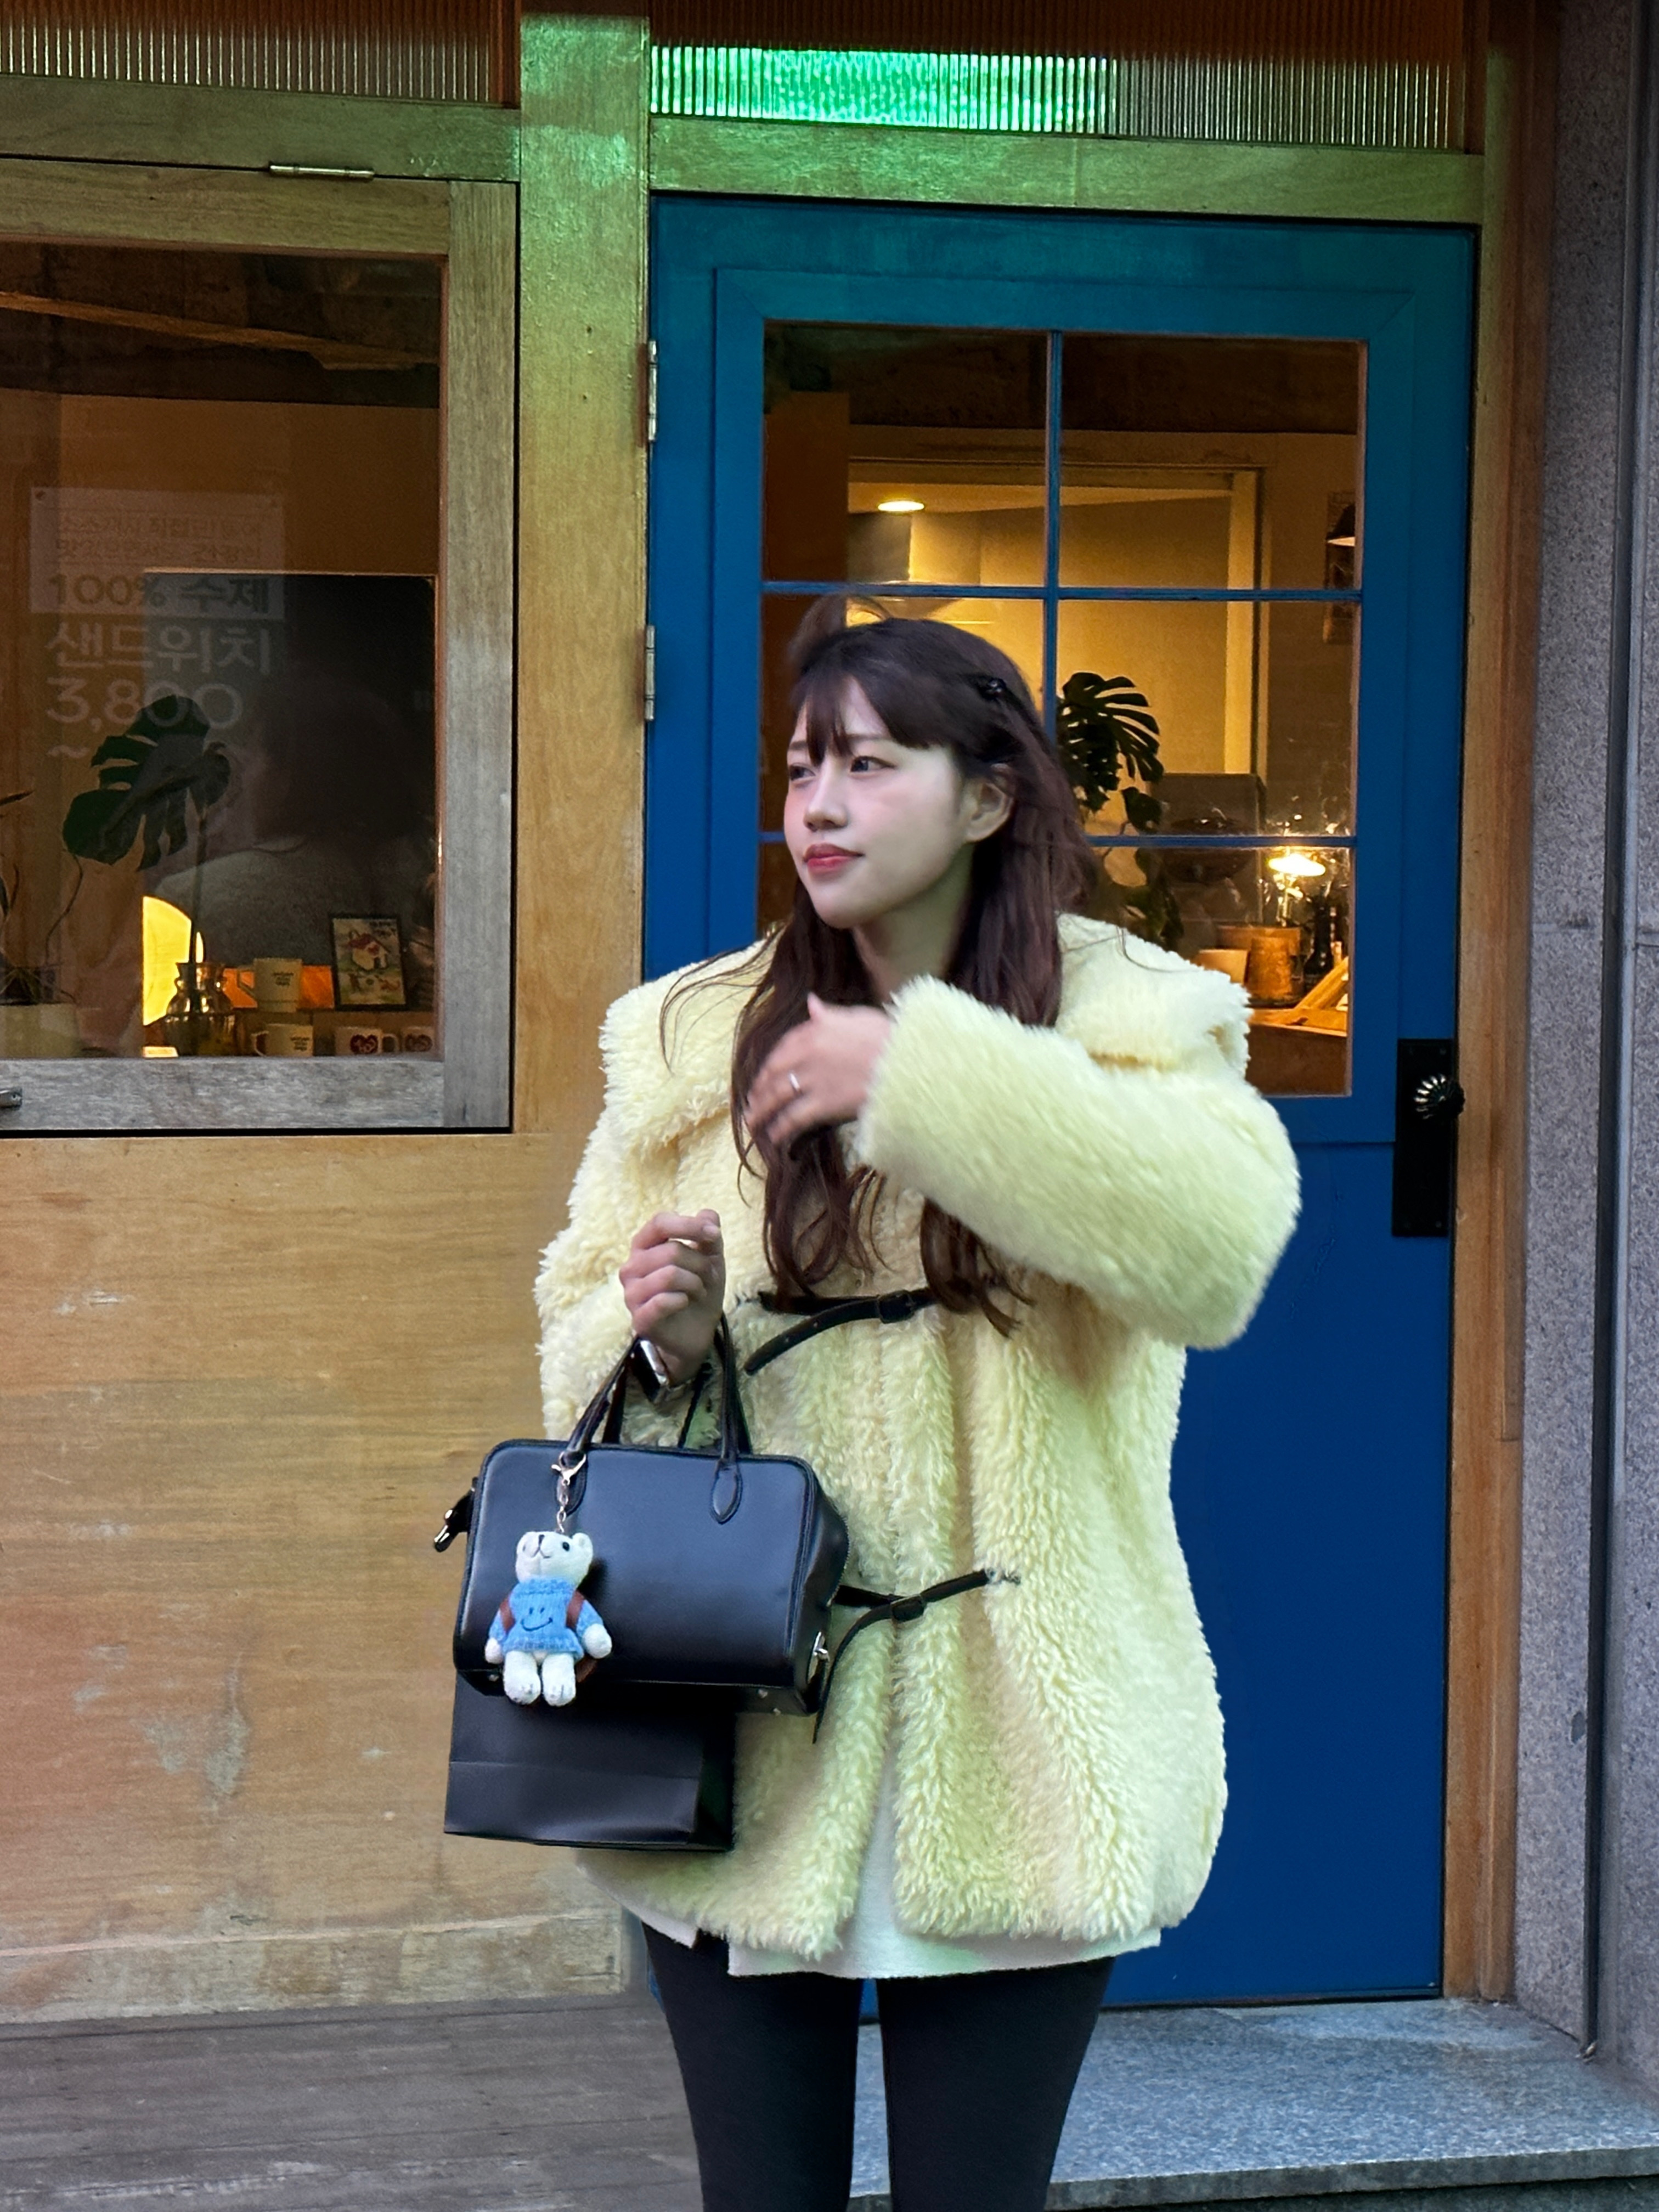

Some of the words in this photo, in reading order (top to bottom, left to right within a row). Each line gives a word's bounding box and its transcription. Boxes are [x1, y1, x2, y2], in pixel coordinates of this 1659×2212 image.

[48, 573, 166, 607] 100%
[180, 577, 269, 614] 수제
[45, 622, 270, 675] 샌드위치
[46, 678, 242, 733] 3,800
